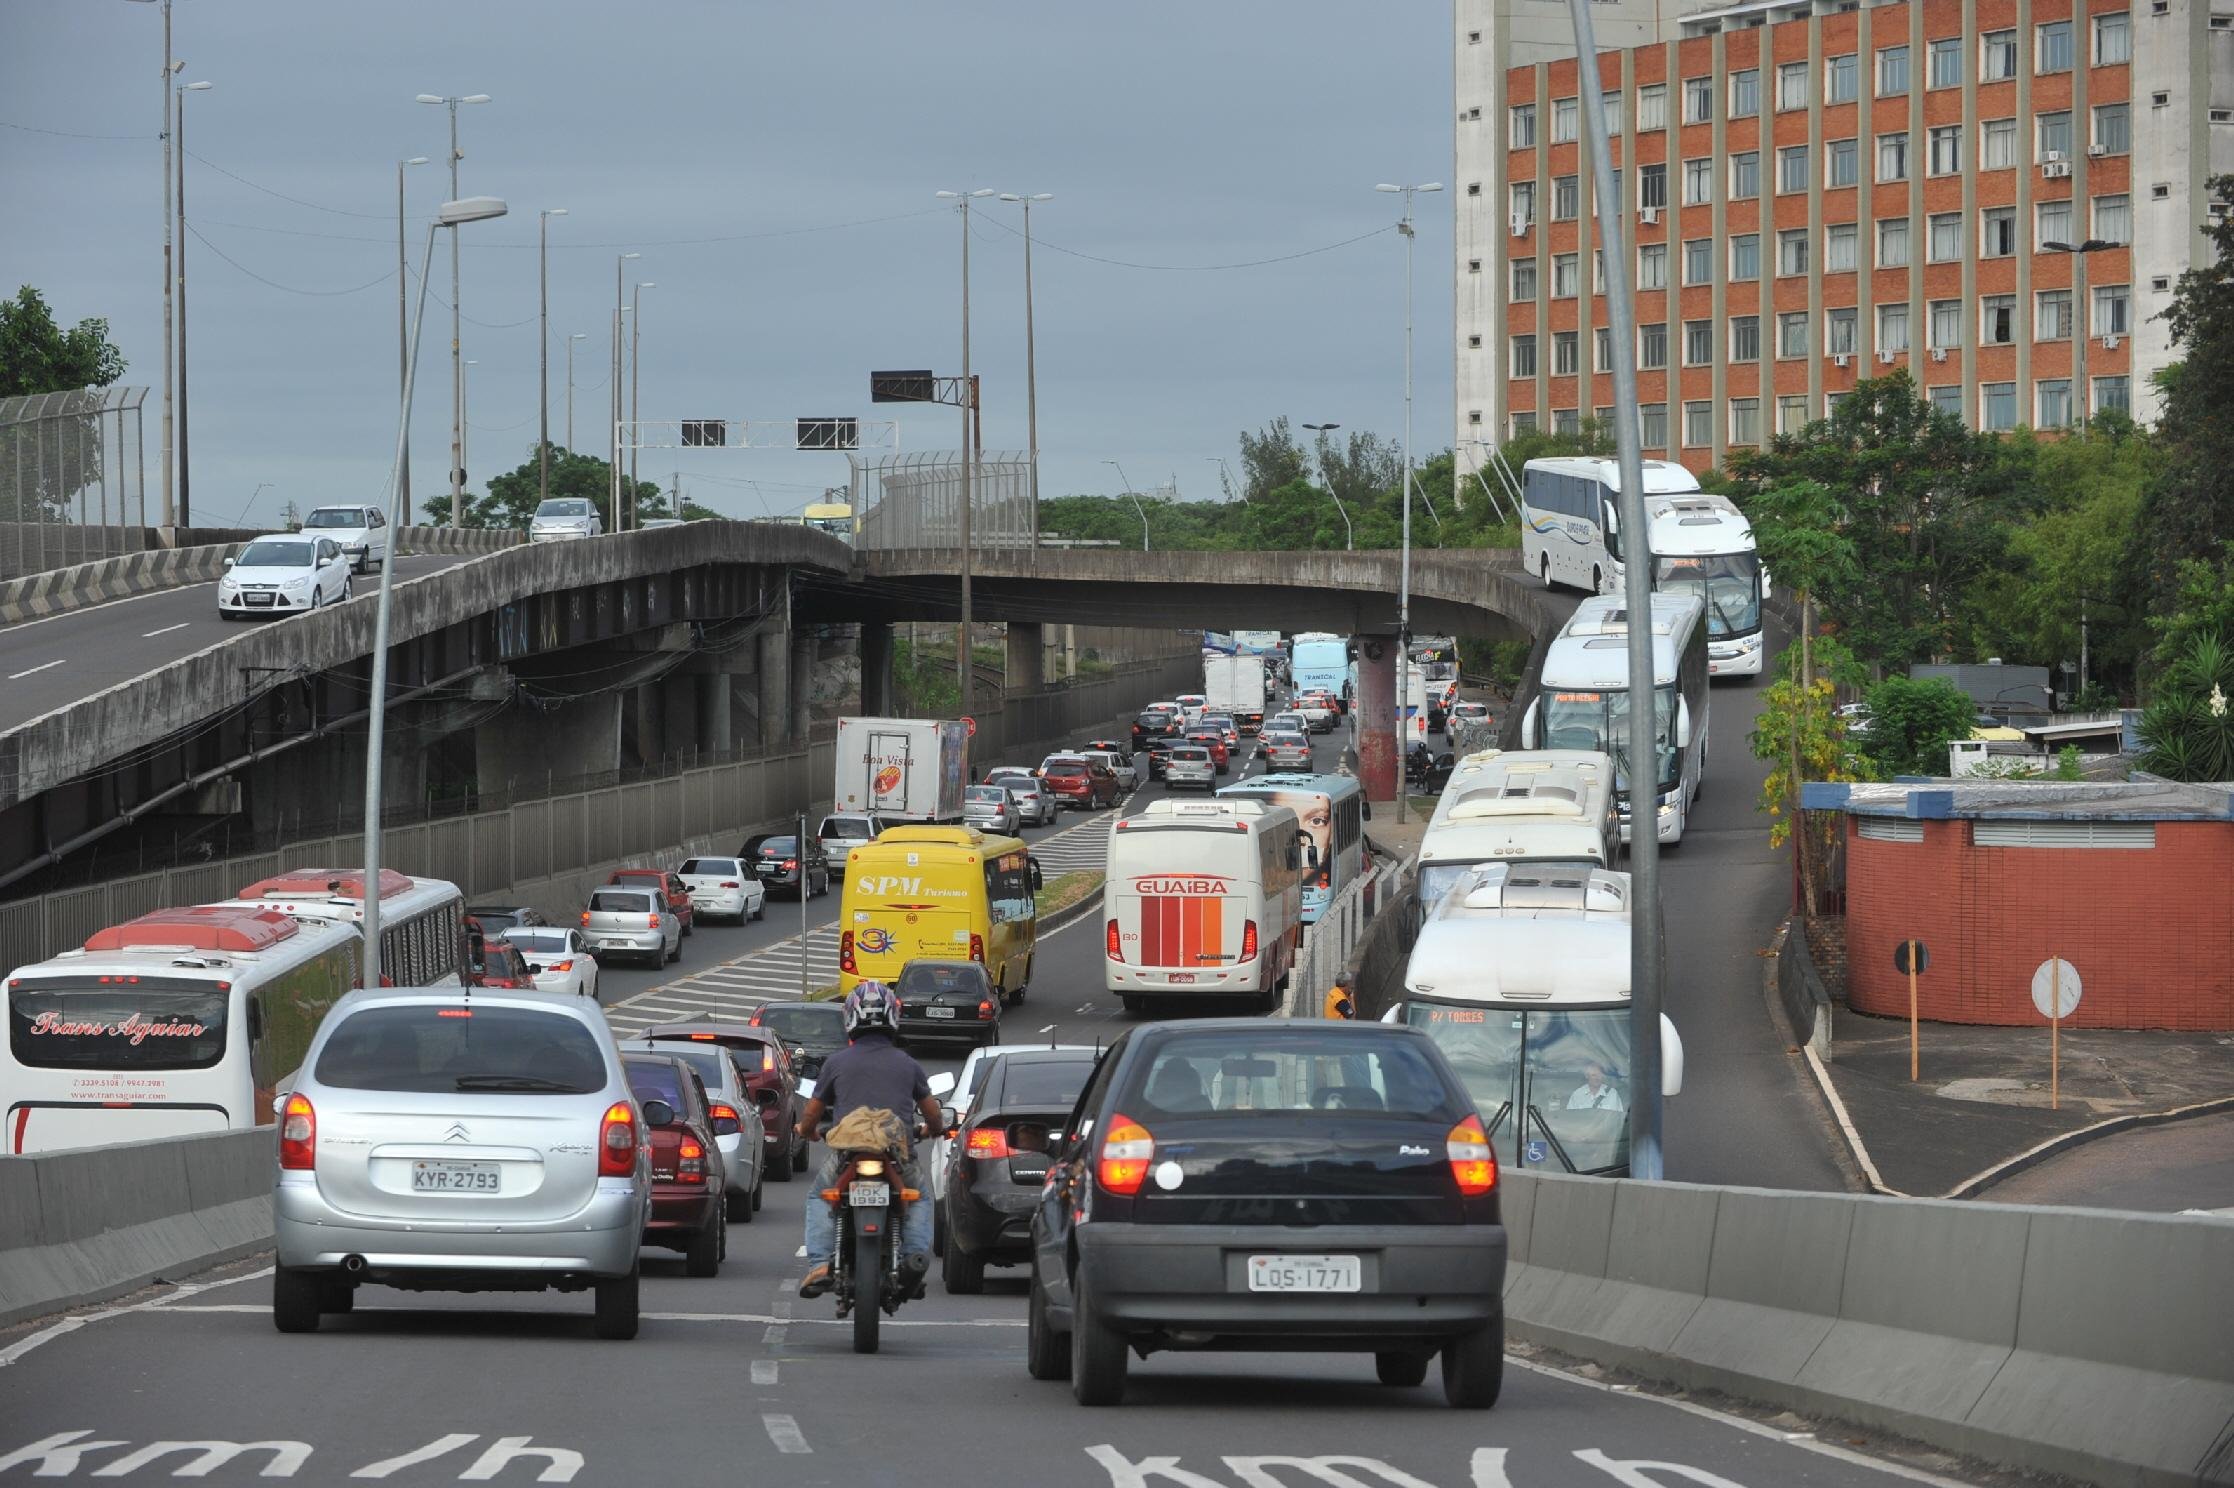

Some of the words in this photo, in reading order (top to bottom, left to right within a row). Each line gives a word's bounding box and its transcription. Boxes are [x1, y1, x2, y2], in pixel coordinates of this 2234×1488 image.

[856, 875, 923, 896] SPM
[924, 887, 968, 897] Turismo
[31, 1010, 109, 1036] Trans
[109, 1012, 208, 1046] Aguiar
